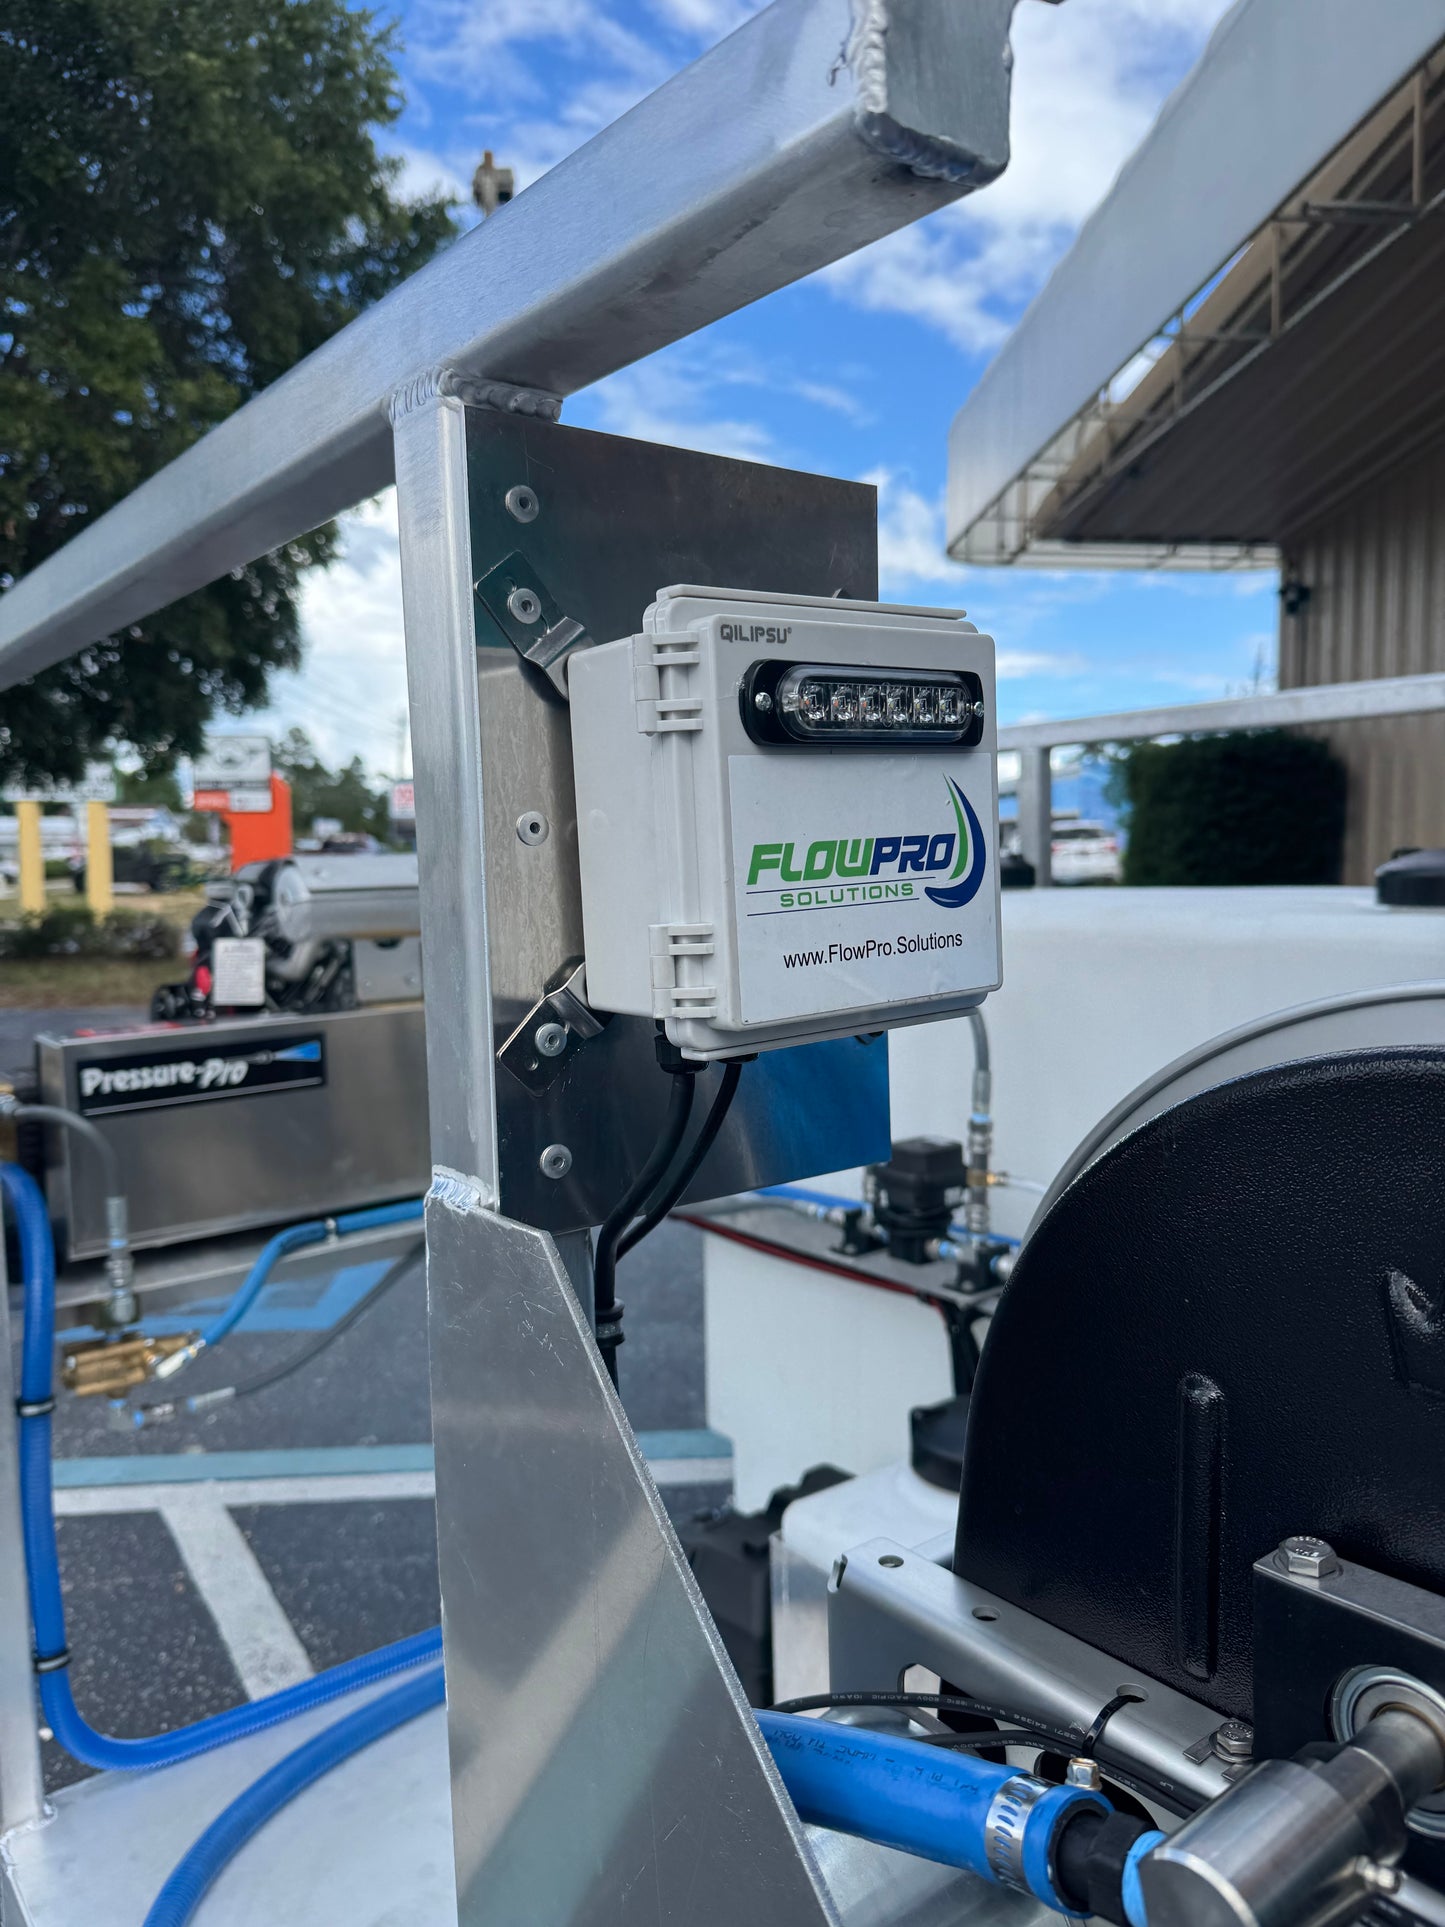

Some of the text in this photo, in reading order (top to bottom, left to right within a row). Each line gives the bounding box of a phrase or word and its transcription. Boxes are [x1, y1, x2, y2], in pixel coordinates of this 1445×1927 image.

[746, 833, 956, 886] FLOWPRO
[780, 883, 914, 908] SOLUTIONS
[783, 931, 963, 969] www.FlowPro.Solutions
[80, 1058, 249, 1097] Pressure-Pro
